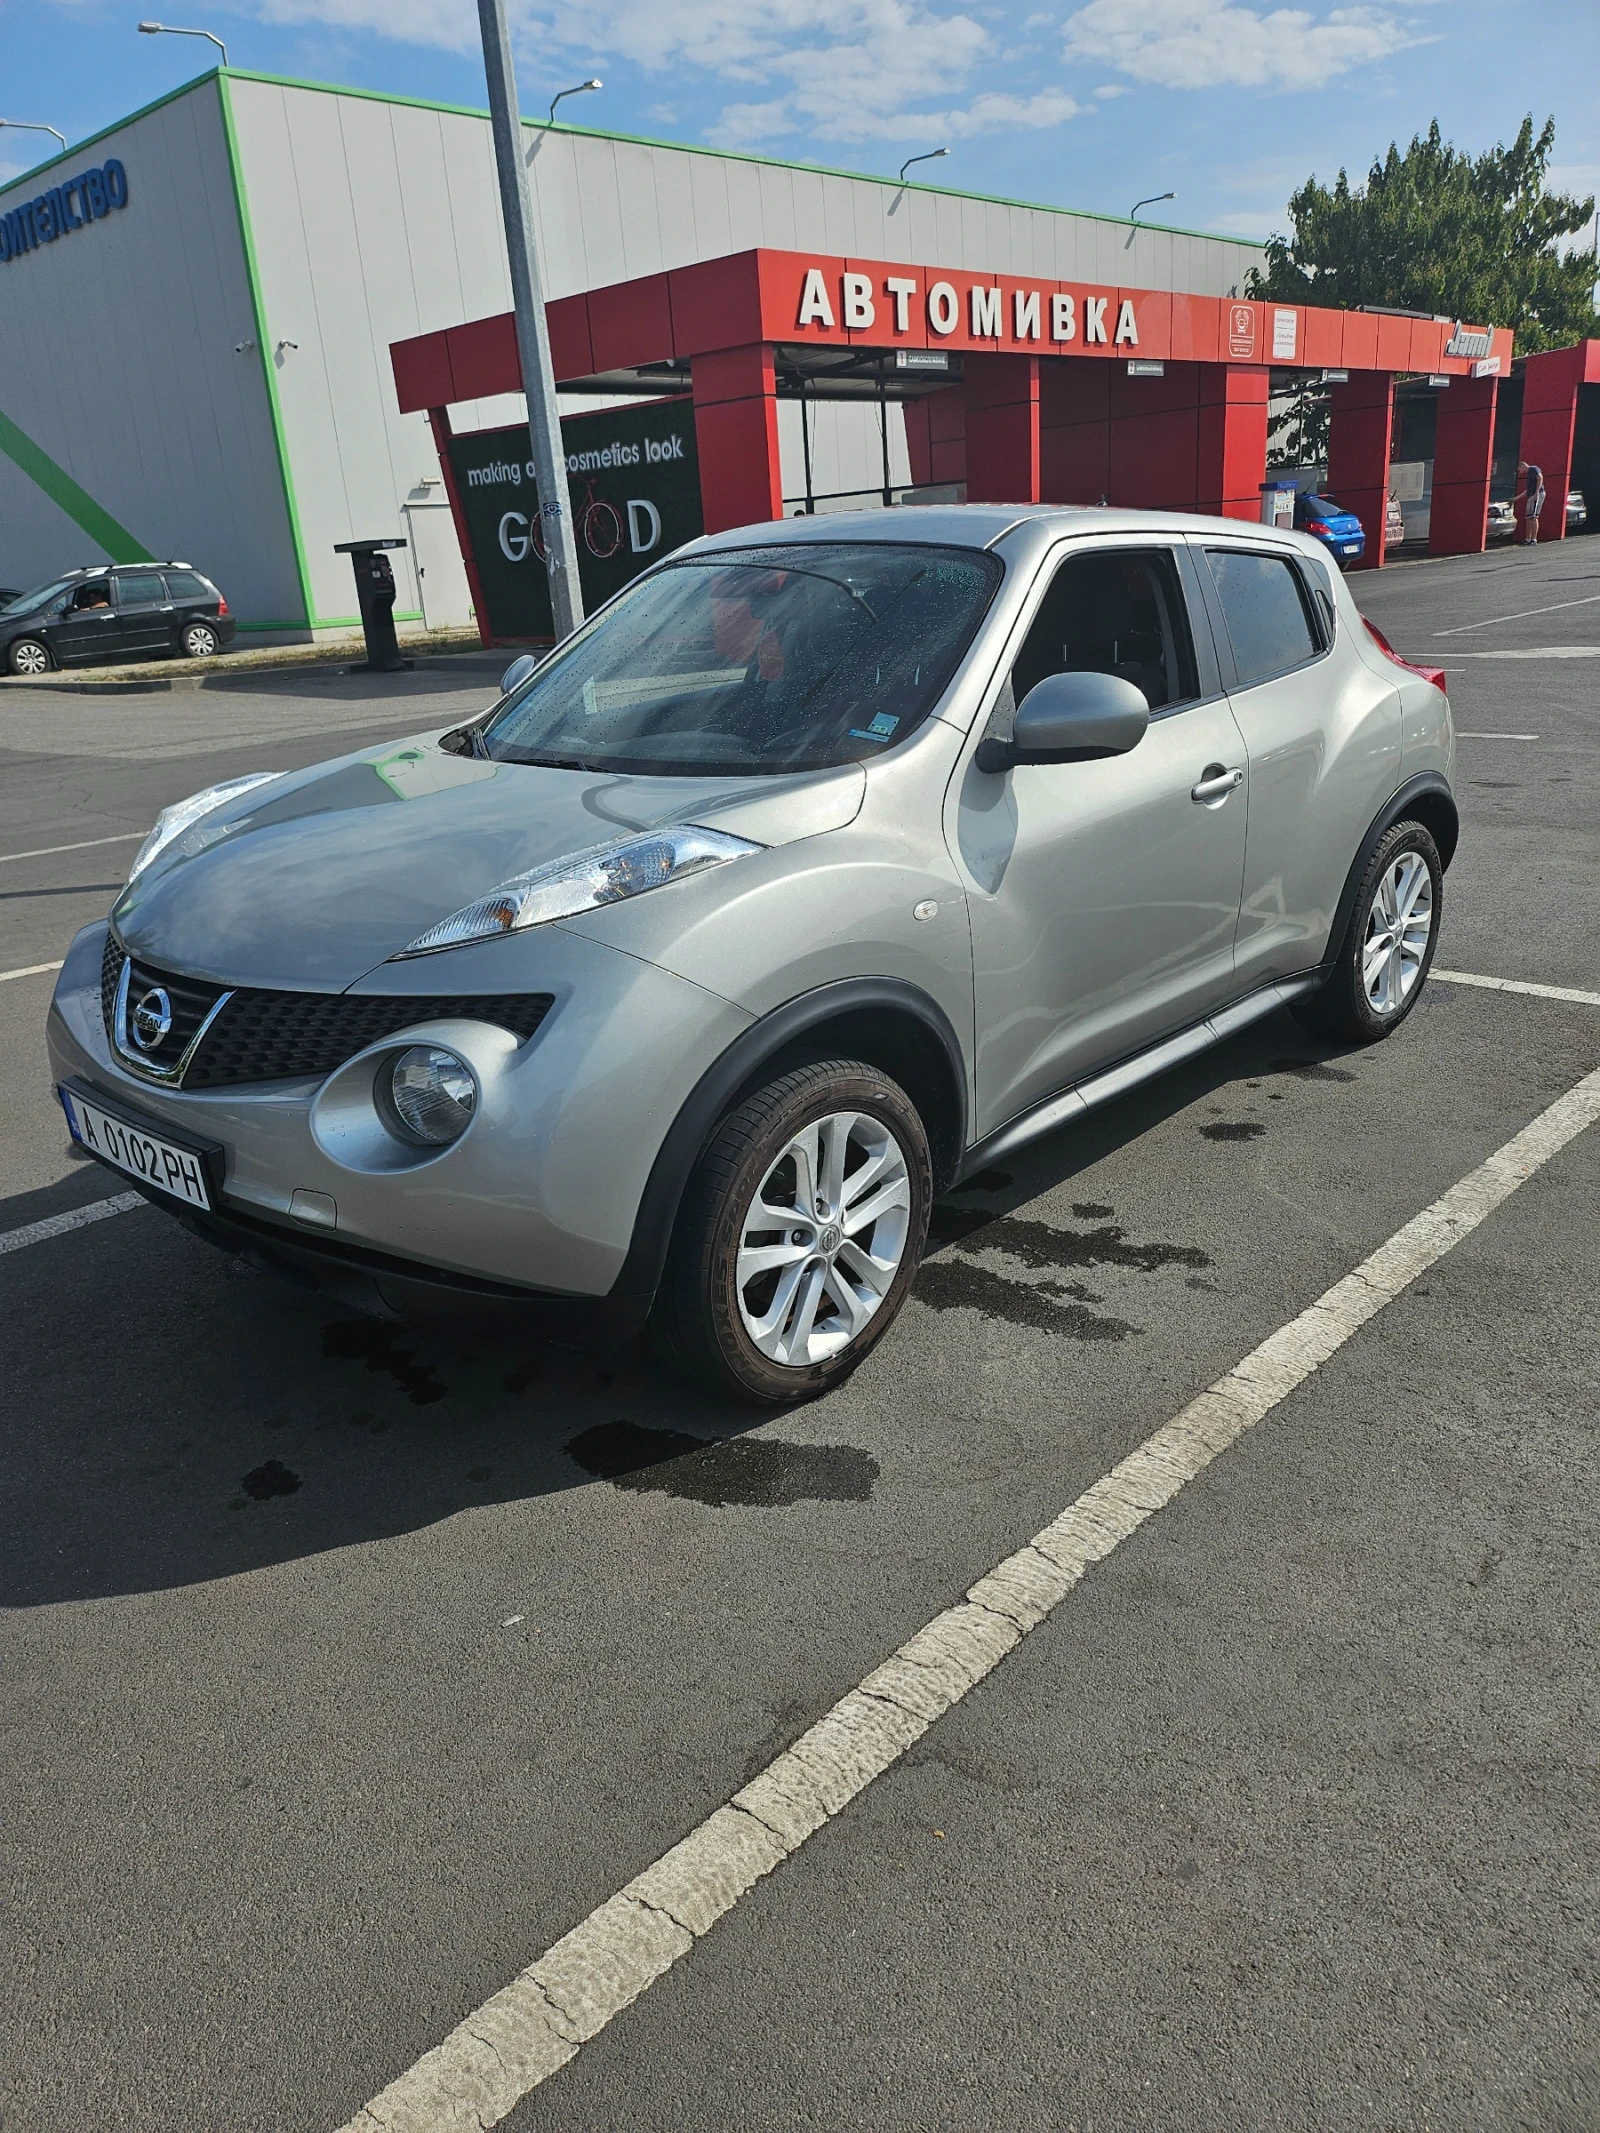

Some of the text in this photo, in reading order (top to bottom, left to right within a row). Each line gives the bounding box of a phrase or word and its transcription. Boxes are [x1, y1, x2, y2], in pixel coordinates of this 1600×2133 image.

[799, 269, 1138, 345] АВТОМИВКА
[468, 461, 521, 487] making
[644, 433, 684, 463] look
[82, 1106, 100, 1148] A
[914, 1146, 933, 1266] TOYO
[712, 1254, 767, 1385] PROXES
